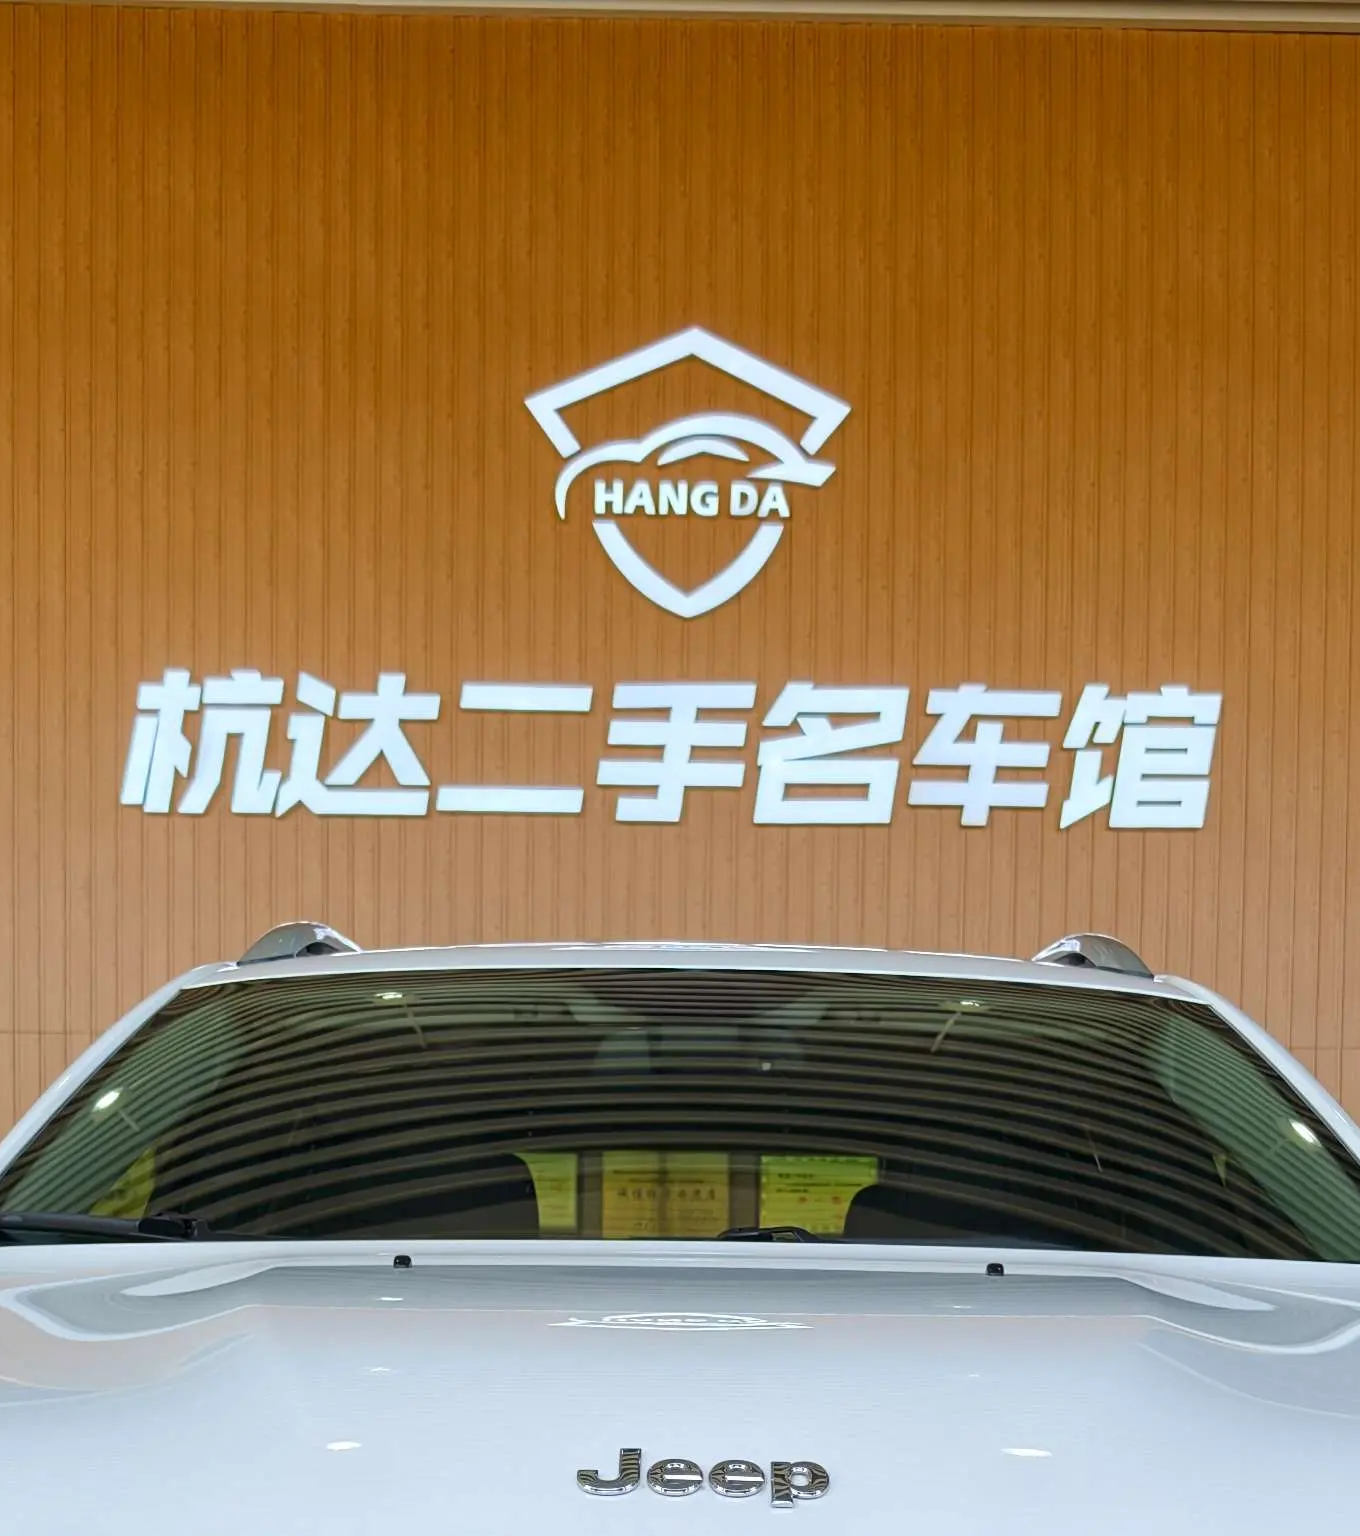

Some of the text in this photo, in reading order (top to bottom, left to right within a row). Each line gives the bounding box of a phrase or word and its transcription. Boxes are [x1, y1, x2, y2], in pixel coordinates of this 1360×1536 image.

[593, 480, 790, 518] HANG DA
[120, 669, 1222, 830] 杭达二手名车馆
[576, 1448, 830, 1508] Jeep
